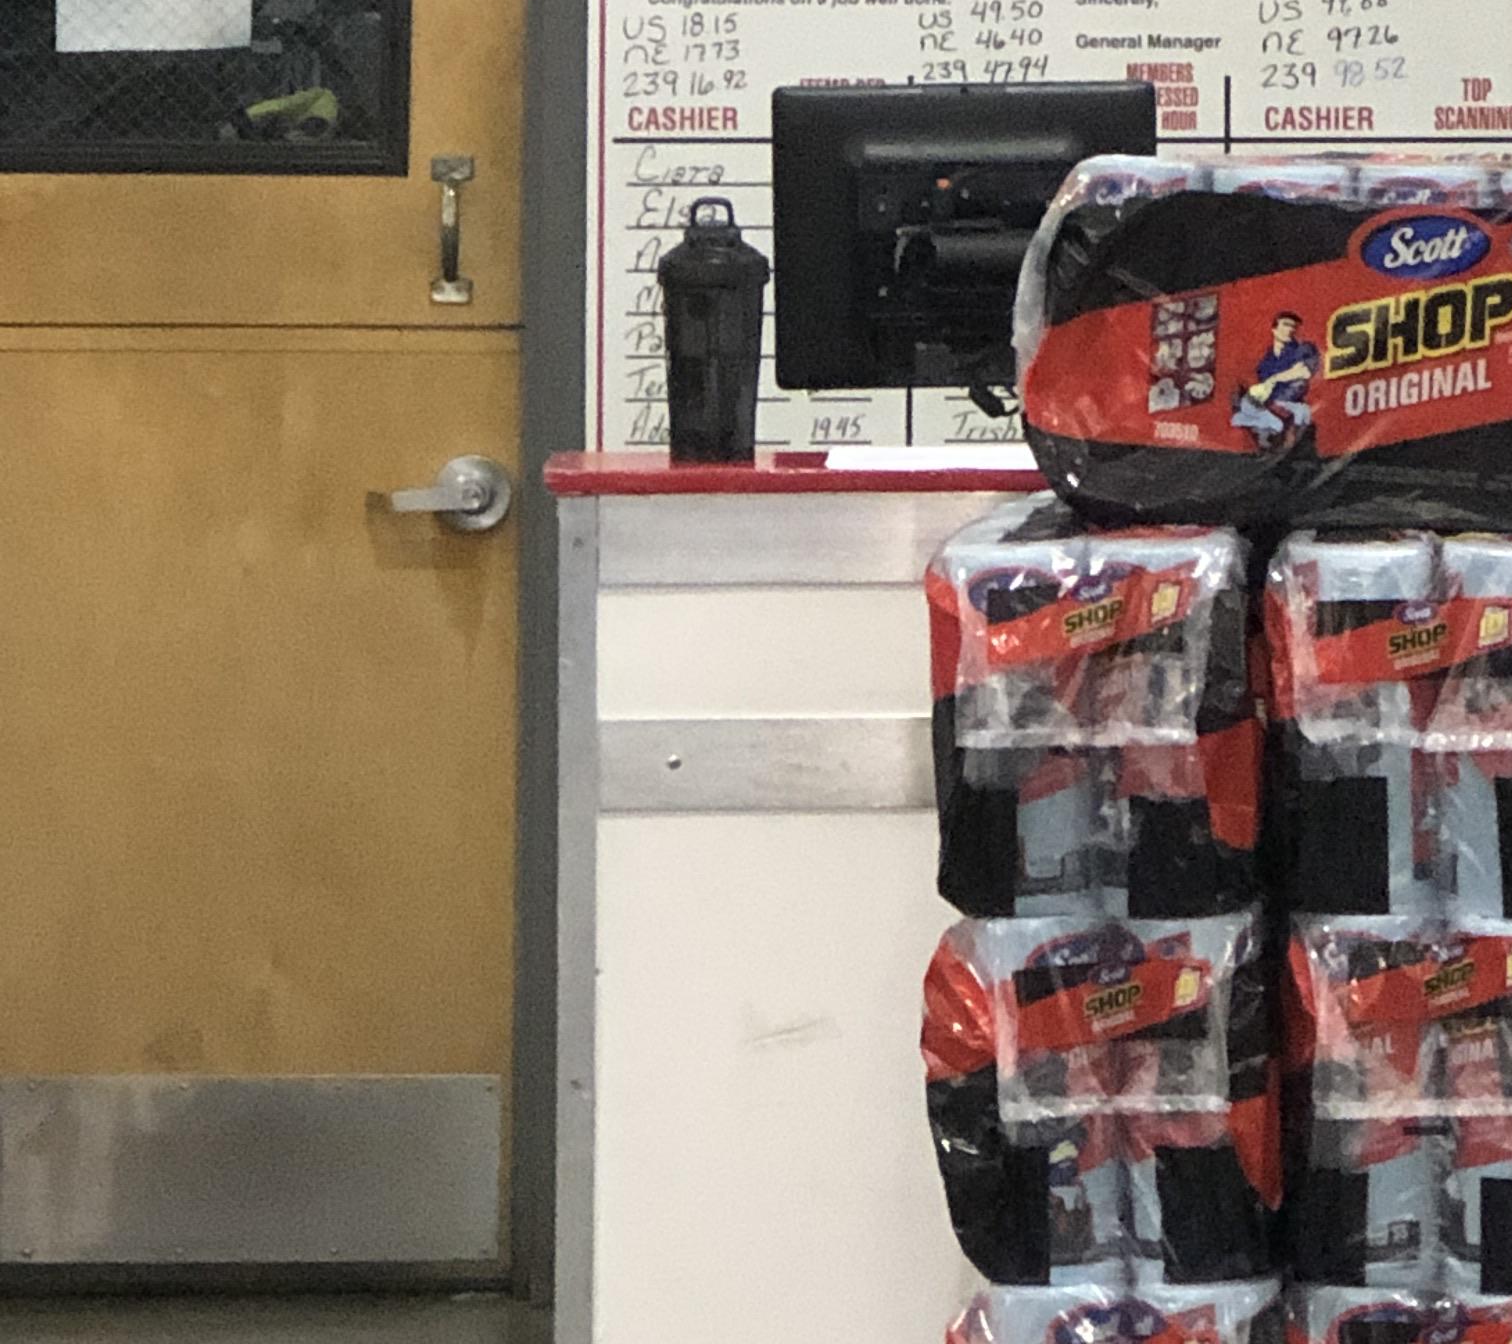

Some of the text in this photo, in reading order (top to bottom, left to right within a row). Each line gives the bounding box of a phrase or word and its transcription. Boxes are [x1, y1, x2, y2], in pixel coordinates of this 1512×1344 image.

[622, 13, 668, 45] US
[1075, 33, 1222, 53] General Manager
[622, 70, 679, 98] 239
[922, 58, 968, 82] 239
[1126, 62, 1195, 84] MEMBERS
[1261, 62, 1318, 90] 239
[1461, 77, 1492, 102] TOP
[627, 105, 739, 132] CASHIER
[1264, 105, 1375, 132] CASHIER
[1383, 226, 1470, 270] Scott
[1345, 358, 1492, 418] ORIGINAL
[1064, 599, 1125, 634] SHOP
[1388, 622, 1448, 655] SHOP
[1084, 983, 1142, 1015] SHOP
